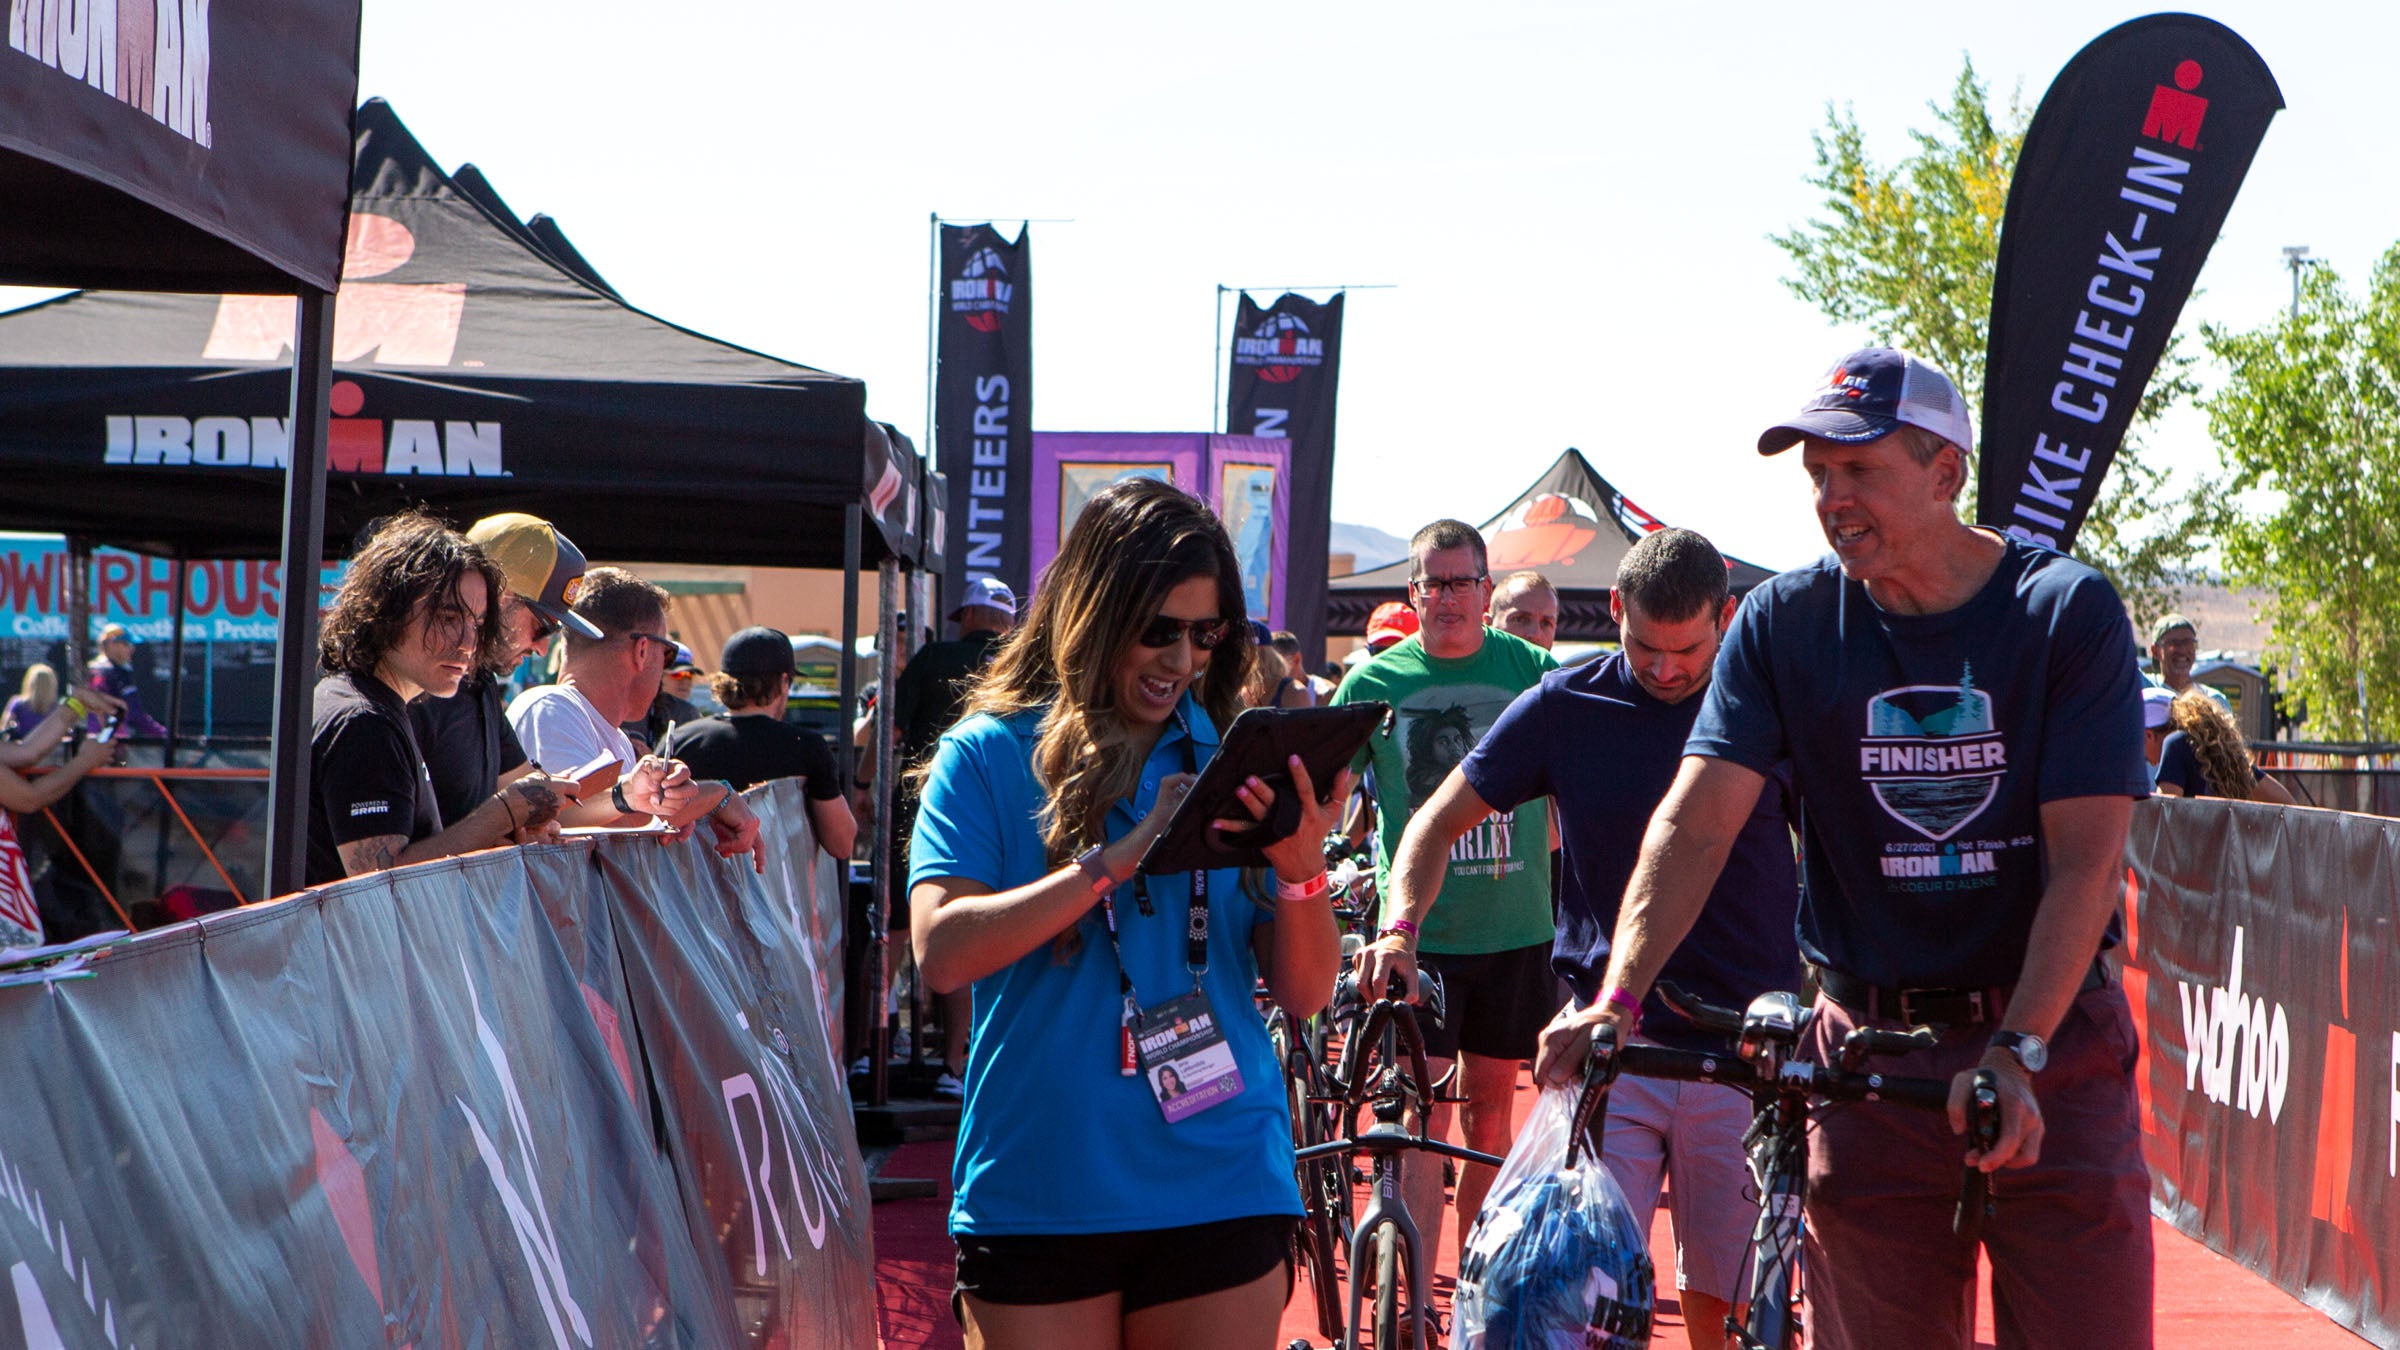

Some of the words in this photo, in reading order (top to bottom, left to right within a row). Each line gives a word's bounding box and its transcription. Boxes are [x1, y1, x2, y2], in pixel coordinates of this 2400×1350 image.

[9, 0, 210, 147] ONMAN
[2051, 146, 2191, 423] CHECK-IN
[104, 413, 502, 477] IRONMAN
[1861, 741, 2007, 772] FINISHER
[351, 806, 389, 816] SRAM
[1450, 823, 1513, 861] RLEY
[1885, 842, 1937, 853] 6/27/2021
[1880, 851, 1996, 877] IRONMAN
[2178, 925, 2290, 1126] wahoo
[1382, 1159, 1393, 1200] BMC
